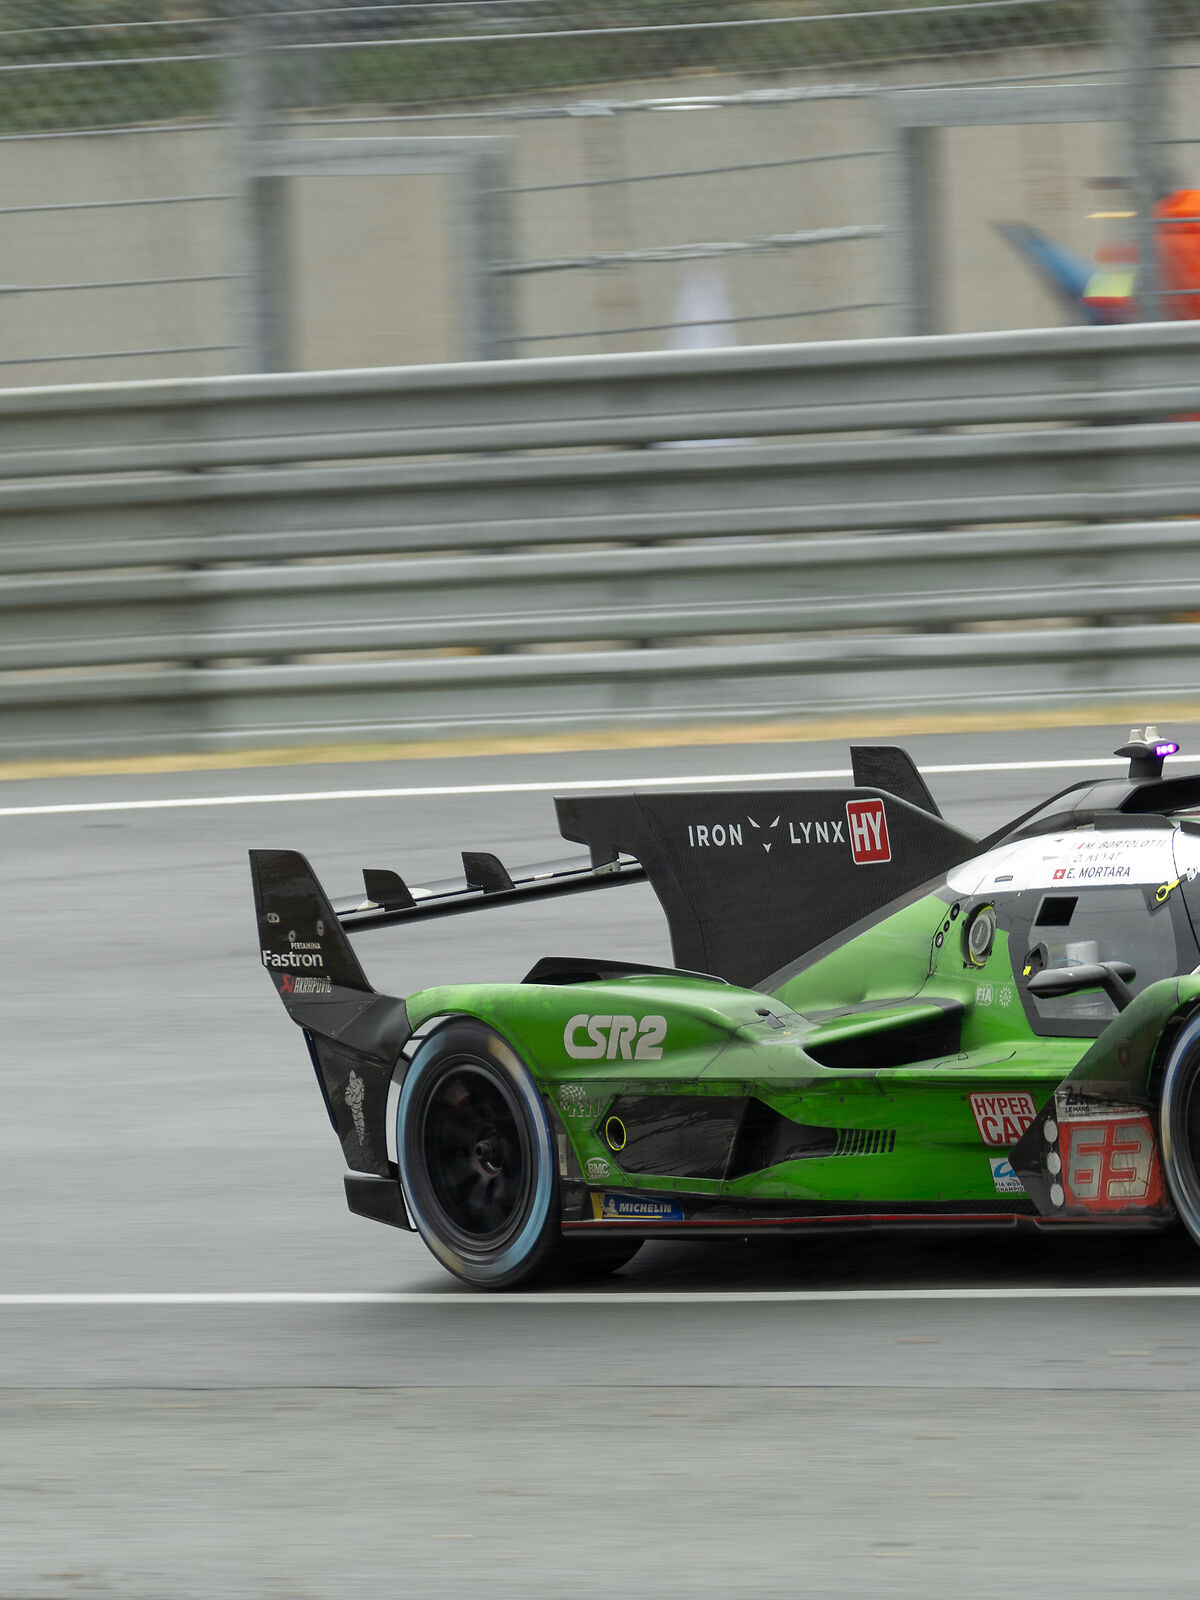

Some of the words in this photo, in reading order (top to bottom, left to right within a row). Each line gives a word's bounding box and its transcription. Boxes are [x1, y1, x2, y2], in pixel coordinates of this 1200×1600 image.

[687, 824, 743, 847] IRON
[789, 821, 845, 844] LYNX
[850, 811, 883, 853] HY
[1097, 839, 1168, 849] BORTOLOTTI
[1066, 867, 1076, 879] E.
[1078, 866, 1131, 878] MORTARA
[290, 942, 322, 950] PERTAMINA
[262, 950, 324, 967] Fastron
[563, 1013, 668, 1060] CSR2
[973, 1096, 1033, 1116] HYPER
[587, 1162, 609, 1175] BMC
[1065, 1123, 1154, 1201] 63
[619, 1203, 672, 1213] MICHELIN
